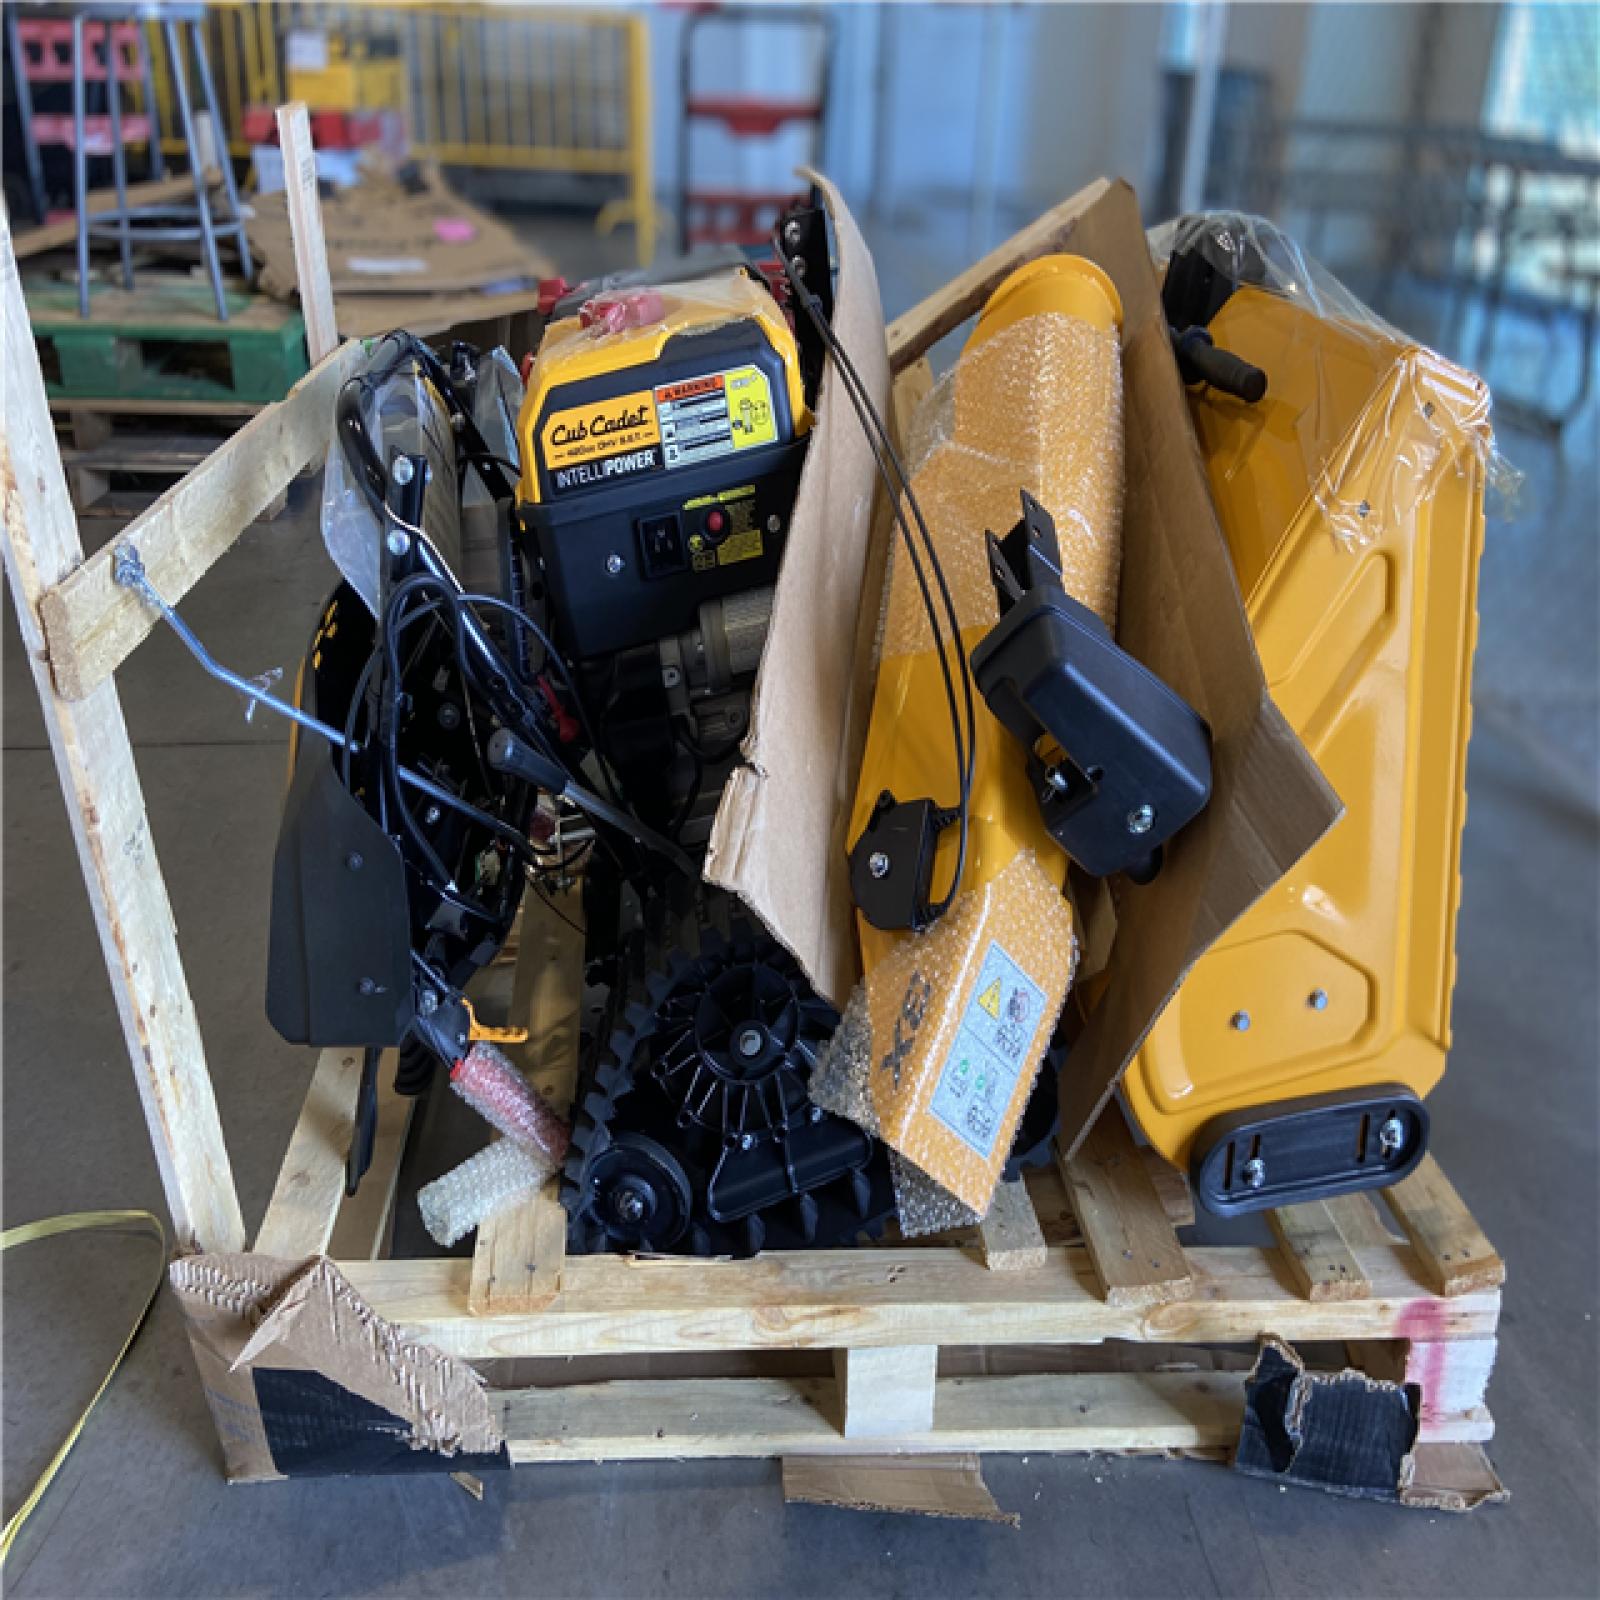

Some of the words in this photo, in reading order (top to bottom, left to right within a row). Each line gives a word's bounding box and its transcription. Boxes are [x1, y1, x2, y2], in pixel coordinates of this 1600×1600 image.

[550, 419, 588, 445] Cub
[590, 405, 648, 435] Cadet
[557, 450, 656, 489] INTELLIPOWER
